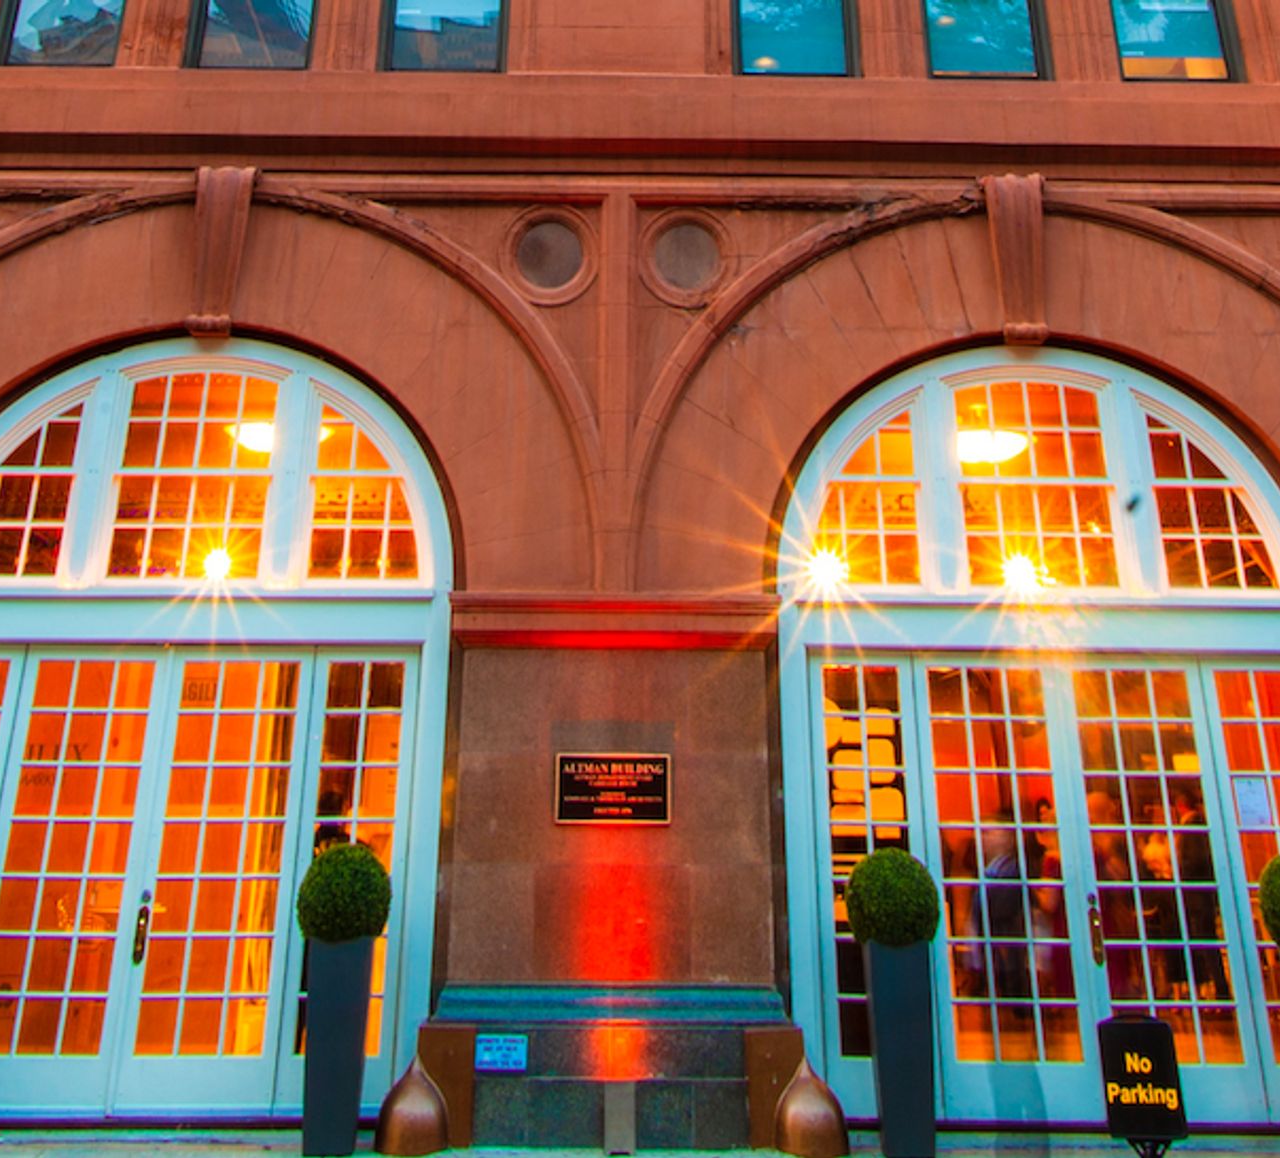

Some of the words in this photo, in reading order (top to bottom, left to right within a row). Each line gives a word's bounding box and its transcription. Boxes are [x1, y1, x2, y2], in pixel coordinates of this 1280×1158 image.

[610, 763, 664, 774] BUILDING
[1124, 1052, 1152, 1073] No
[1106, 1082, 1179, 1110] Parking
